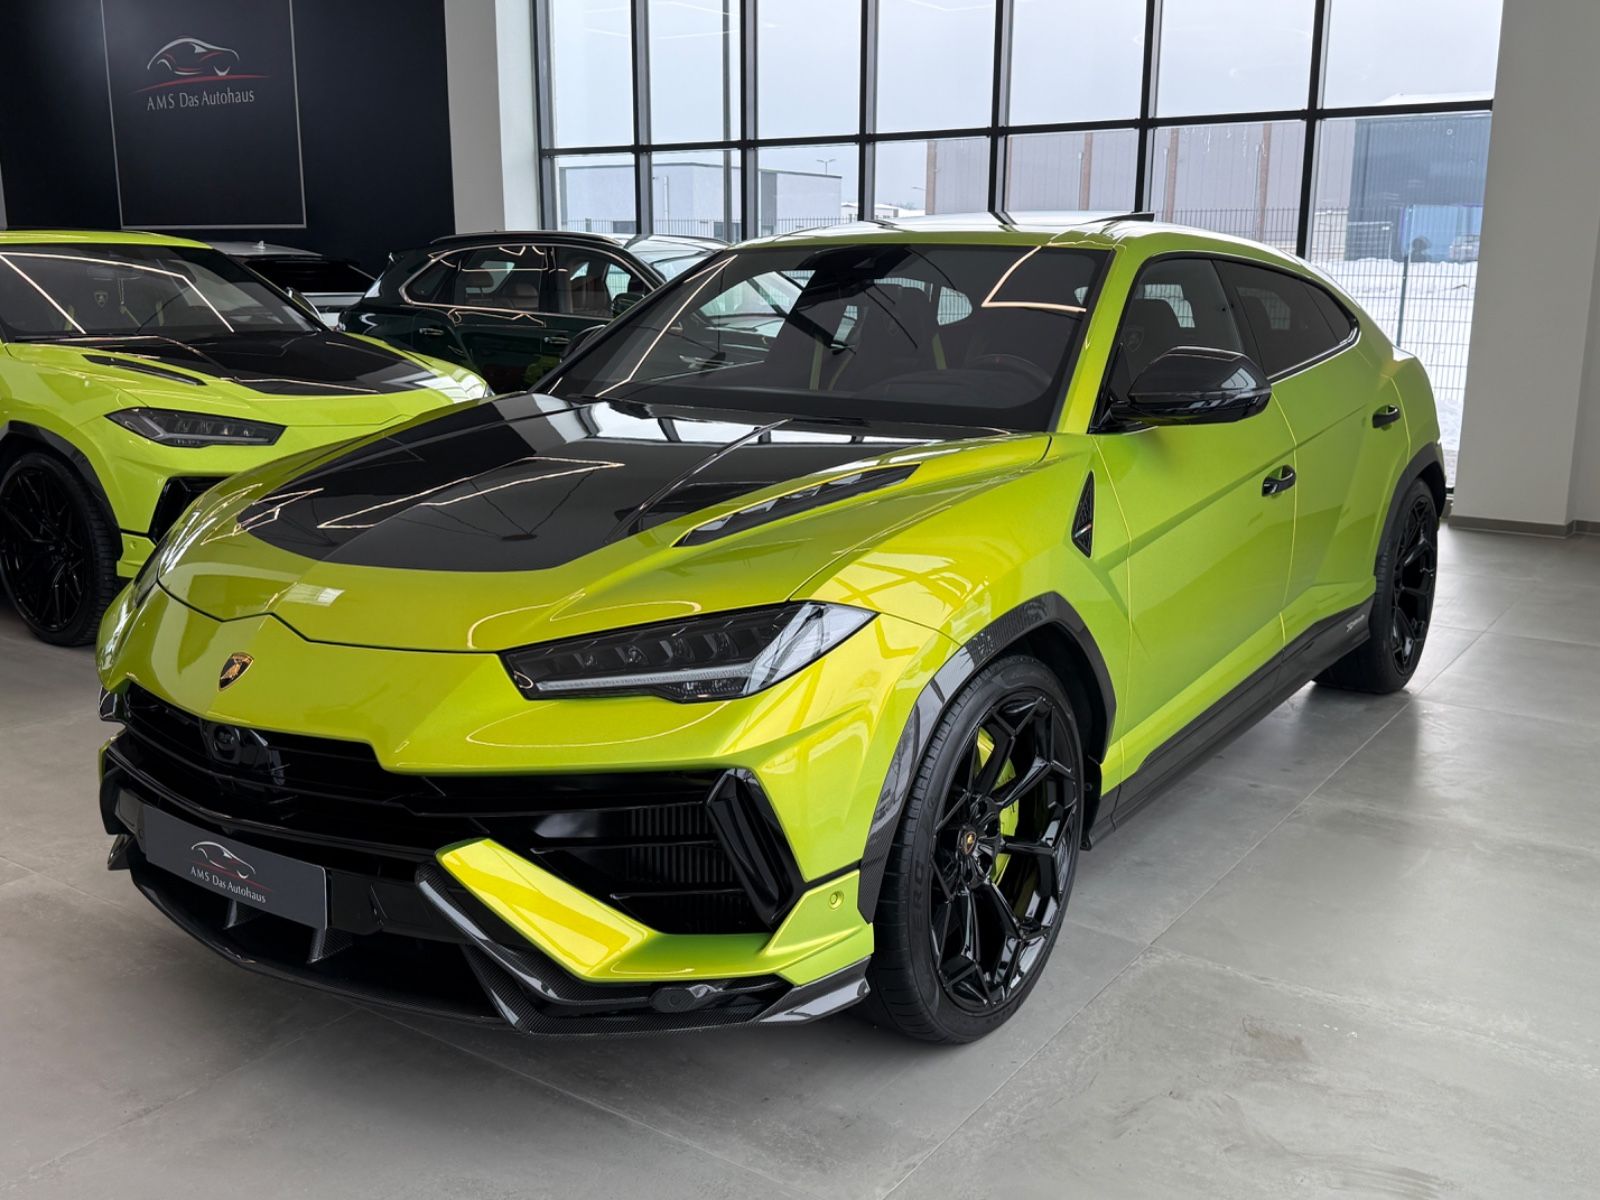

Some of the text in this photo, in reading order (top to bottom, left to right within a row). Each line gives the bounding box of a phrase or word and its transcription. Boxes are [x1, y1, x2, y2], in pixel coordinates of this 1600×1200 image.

[147, 87, 255, 111] AMS Das Autohaus
[190, 865, 266, 903] AMS Das Autohaus
